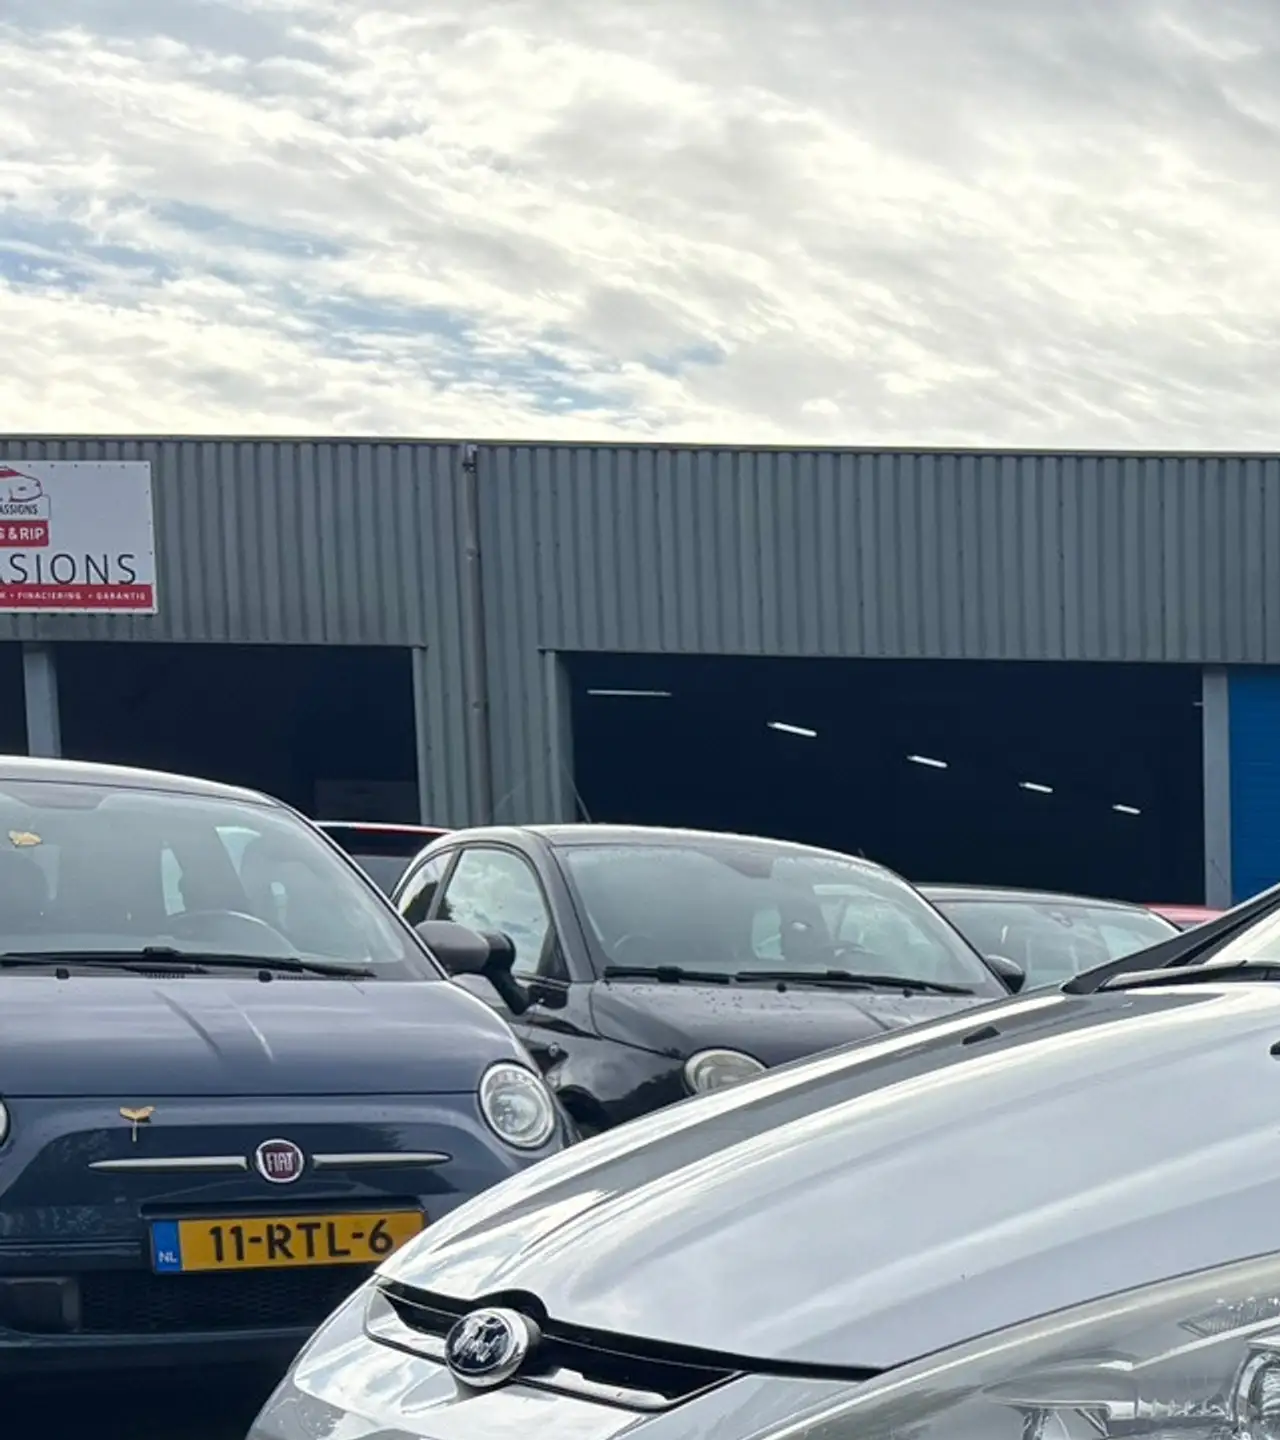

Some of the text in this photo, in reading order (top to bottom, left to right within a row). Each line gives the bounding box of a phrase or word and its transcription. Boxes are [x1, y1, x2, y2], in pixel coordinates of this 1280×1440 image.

[20, 527, 44, 541] RIP
[266, 1151, 295, 1173] FIAT
[209, 1219, 393, 1262] 11-RTL-6
[158, 1251, 177, 1263] NL
